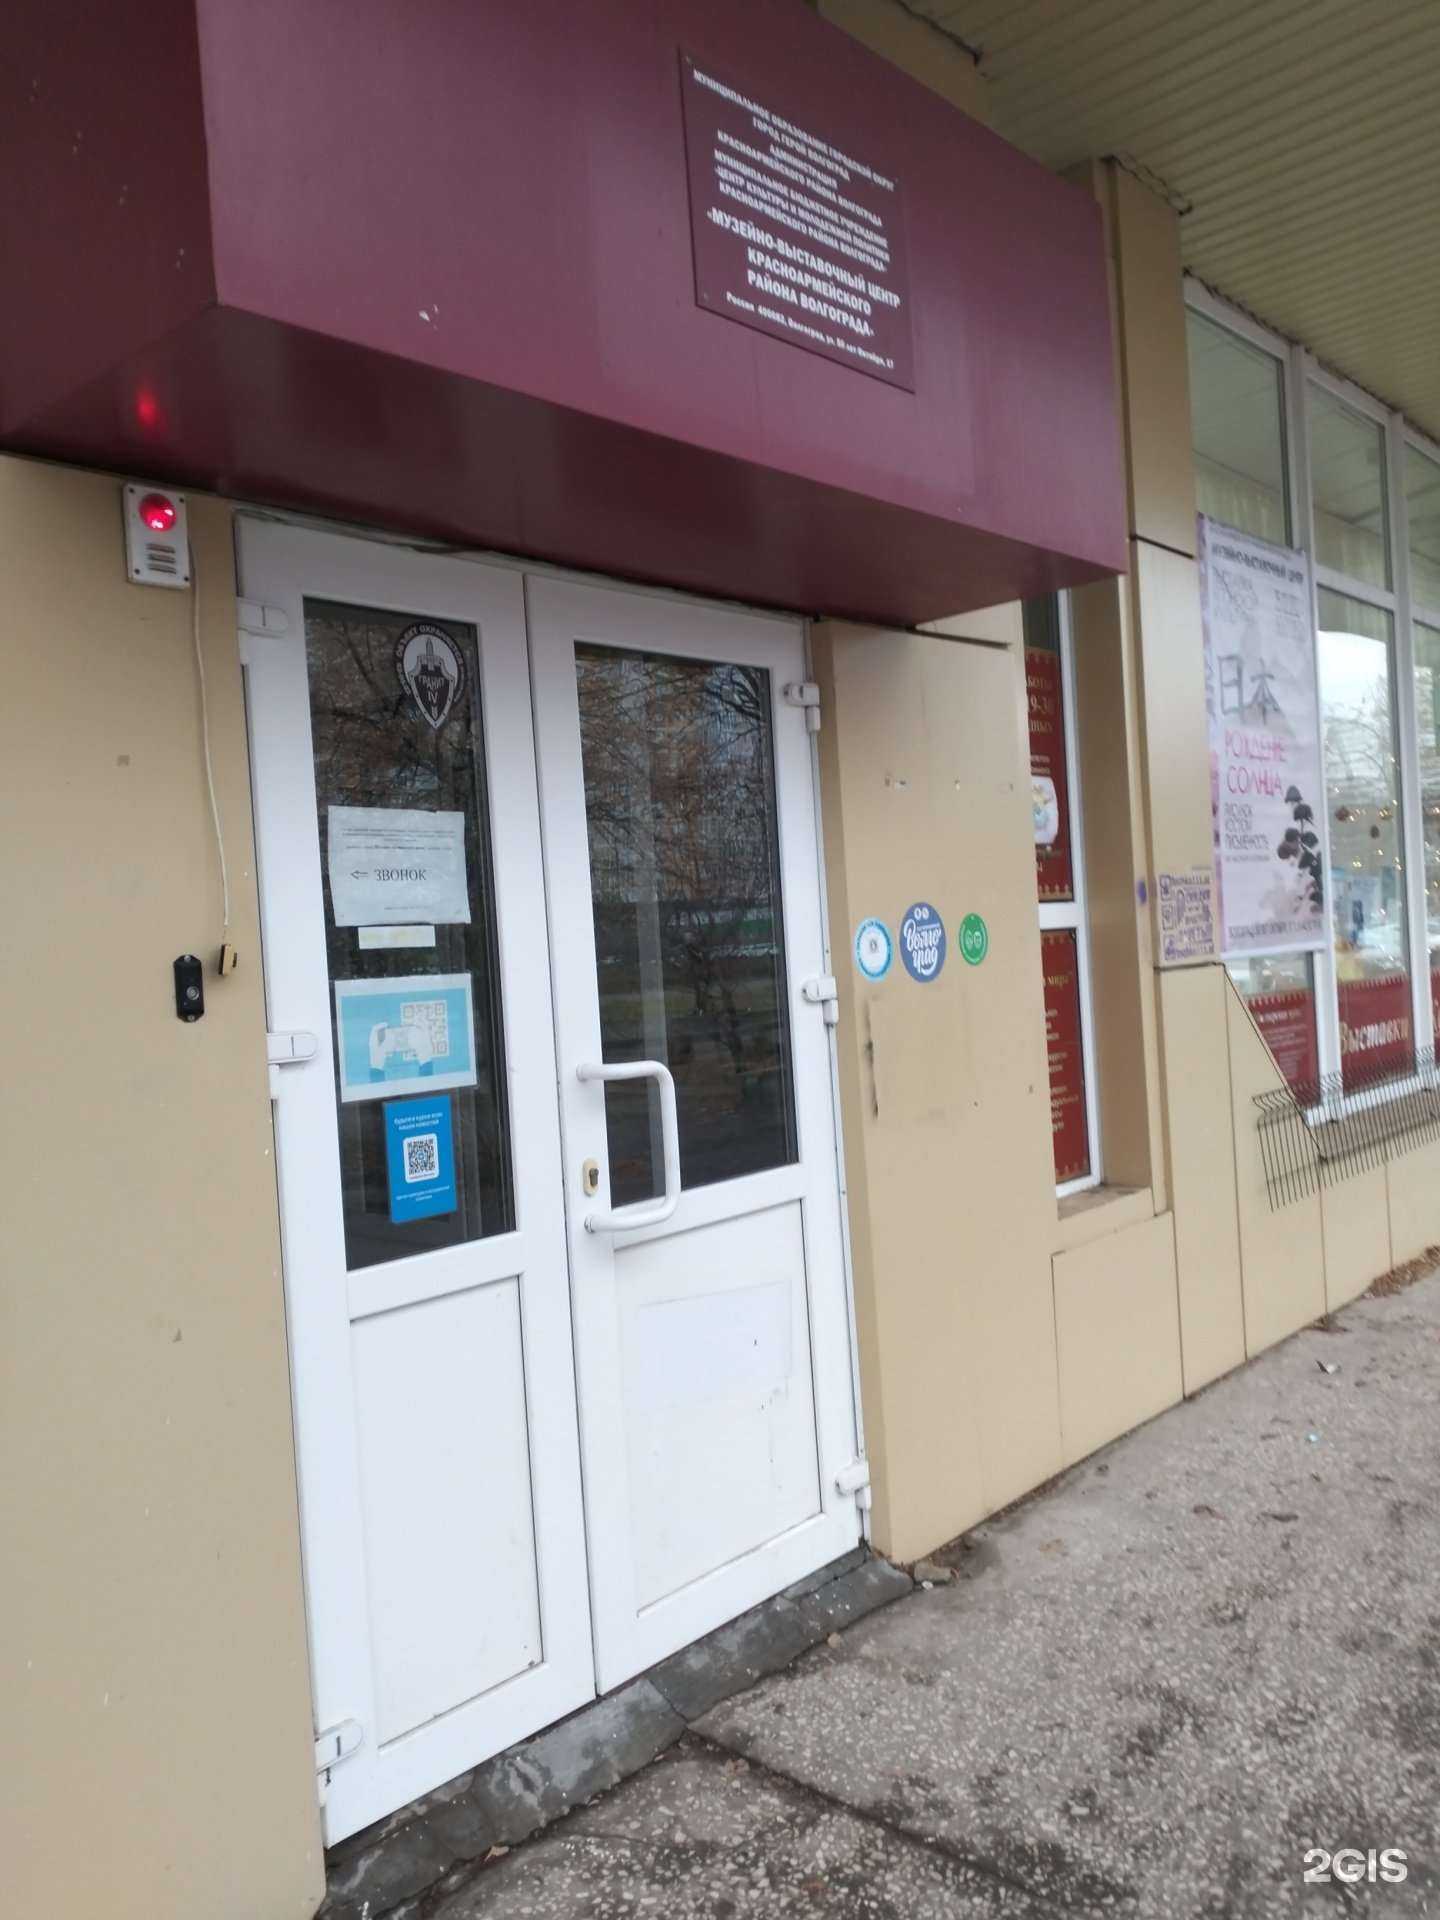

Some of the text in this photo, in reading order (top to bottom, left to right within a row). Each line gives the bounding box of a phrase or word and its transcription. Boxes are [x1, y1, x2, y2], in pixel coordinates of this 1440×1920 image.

[753, 117, 779, 141] ГОРОД
[808, 148, 849, 181] ВОЛГОГРАД
[769, 143, 837, 189] АДМИНИСТРАЦИЯ
[714, 148, 788, 197] МУНИЦИПАЛЬНОЕ
[790, 188, 839, 223] БЮДЖЕТНОЕ
[717, 129, 882, 227] КРАСНОАРМЕЙСКОГО РАЙОНА ВОЛГОГРАДА
[746, 180, 788, 210] КУЛЬТУРЫ
[790, 202, 797, 215] И
[719, 181, 807, 234] КРАСНОАРМЕЙСКОГО
[808, 226, 839, 250] РАЙОНА
[747, 246, 871, 316] КРАСНОАРМЕЙСКОГО
[747, 268, 798, 305] РАЙОНА
[867, 280, 900, 309] ЦЕНТР
[1227, 766, 1285, 796] СОЛНЦА
[374, 868, 427, 881] ЗВОНОК
